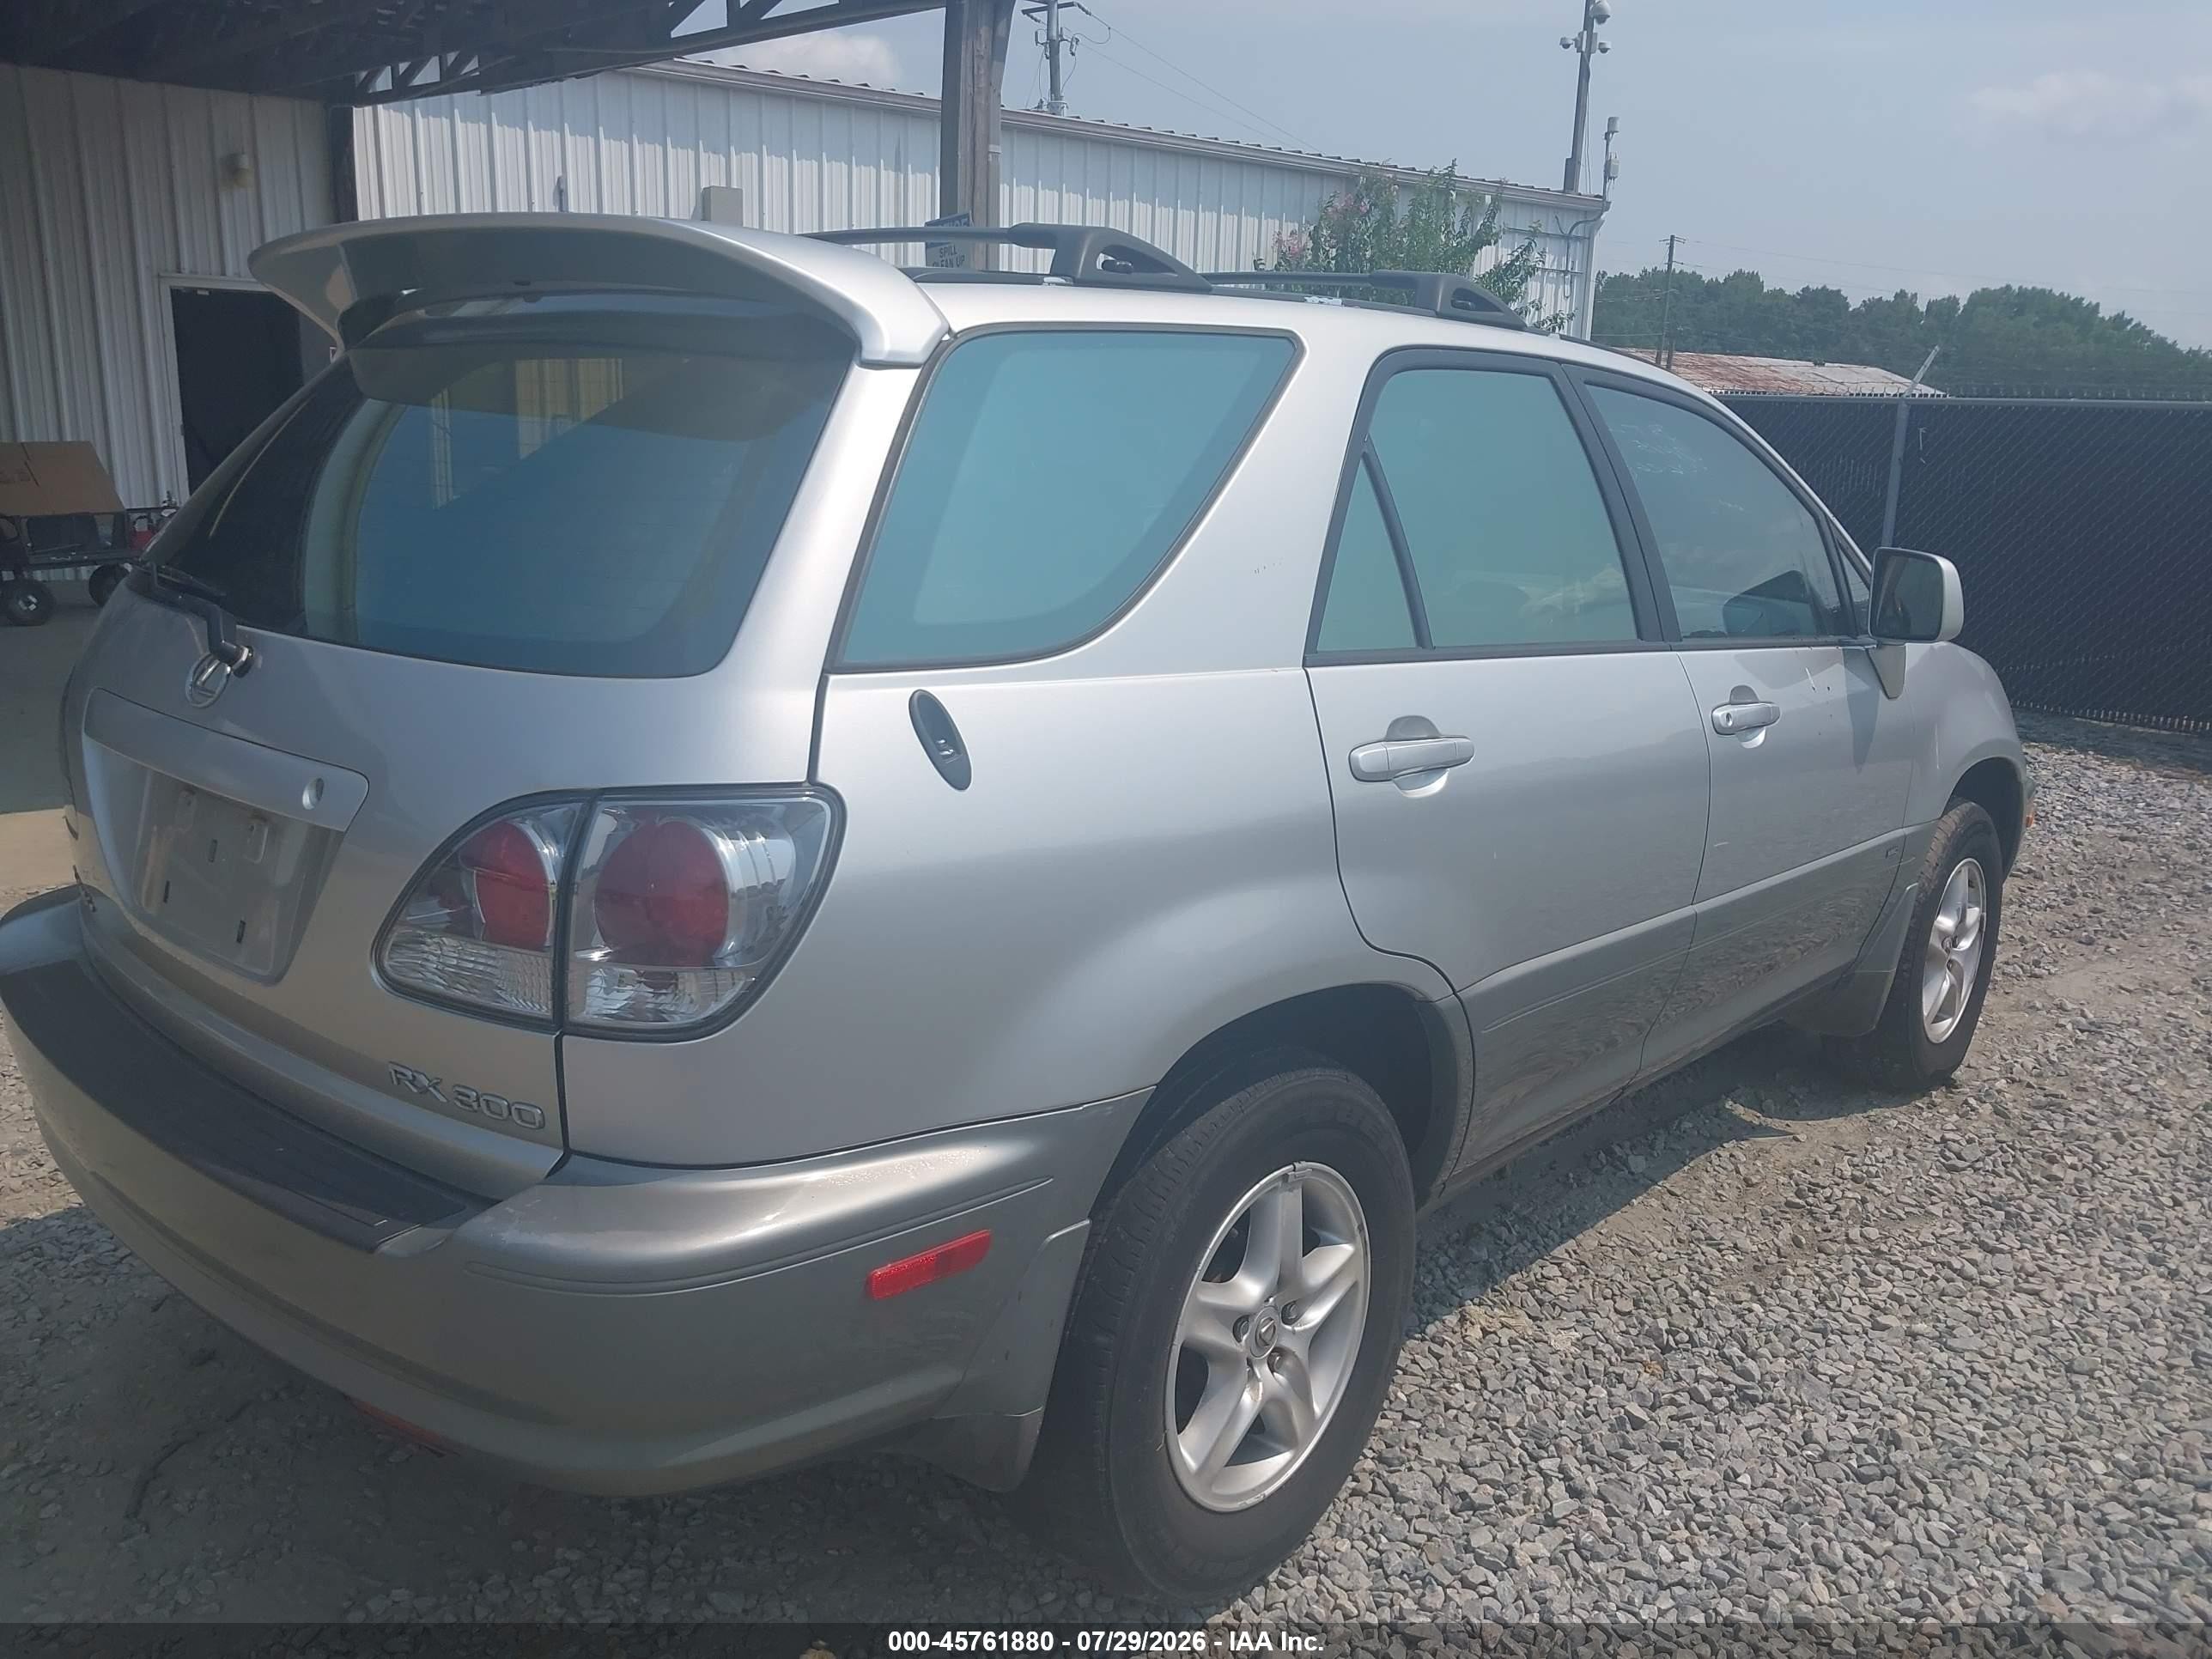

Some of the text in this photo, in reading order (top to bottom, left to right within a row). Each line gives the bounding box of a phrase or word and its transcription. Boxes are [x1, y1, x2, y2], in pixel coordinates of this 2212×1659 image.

[939, 245, 957, 258] SPILL
[956, 254, 965, 268] UP
[388, 1060, 546, 1130] RX 300
